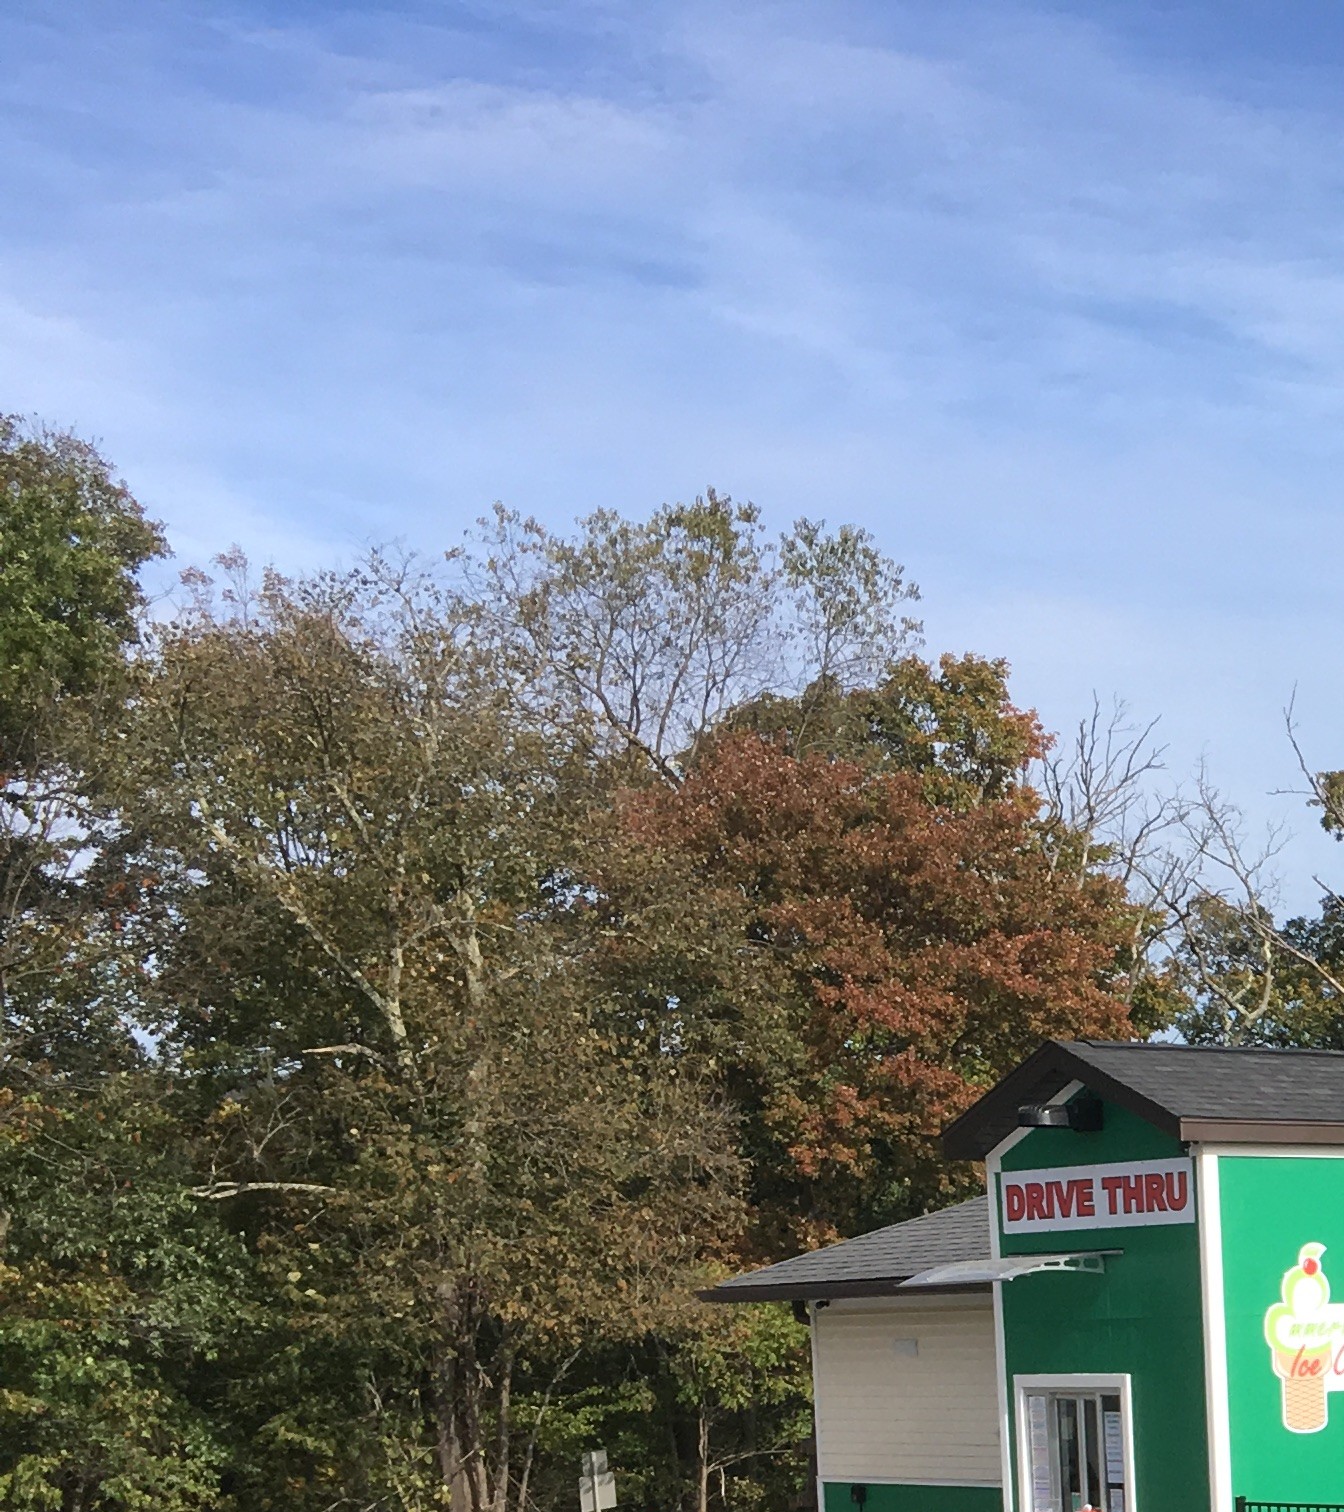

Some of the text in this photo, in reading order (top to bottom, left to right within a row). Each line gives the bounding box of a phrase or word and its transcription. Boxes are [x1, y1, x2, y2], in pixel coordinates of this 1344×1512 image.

[1006, 1171, 1188, 1222] DRIVE THRU
[1290, 1343, 1322, 1379] Ice
